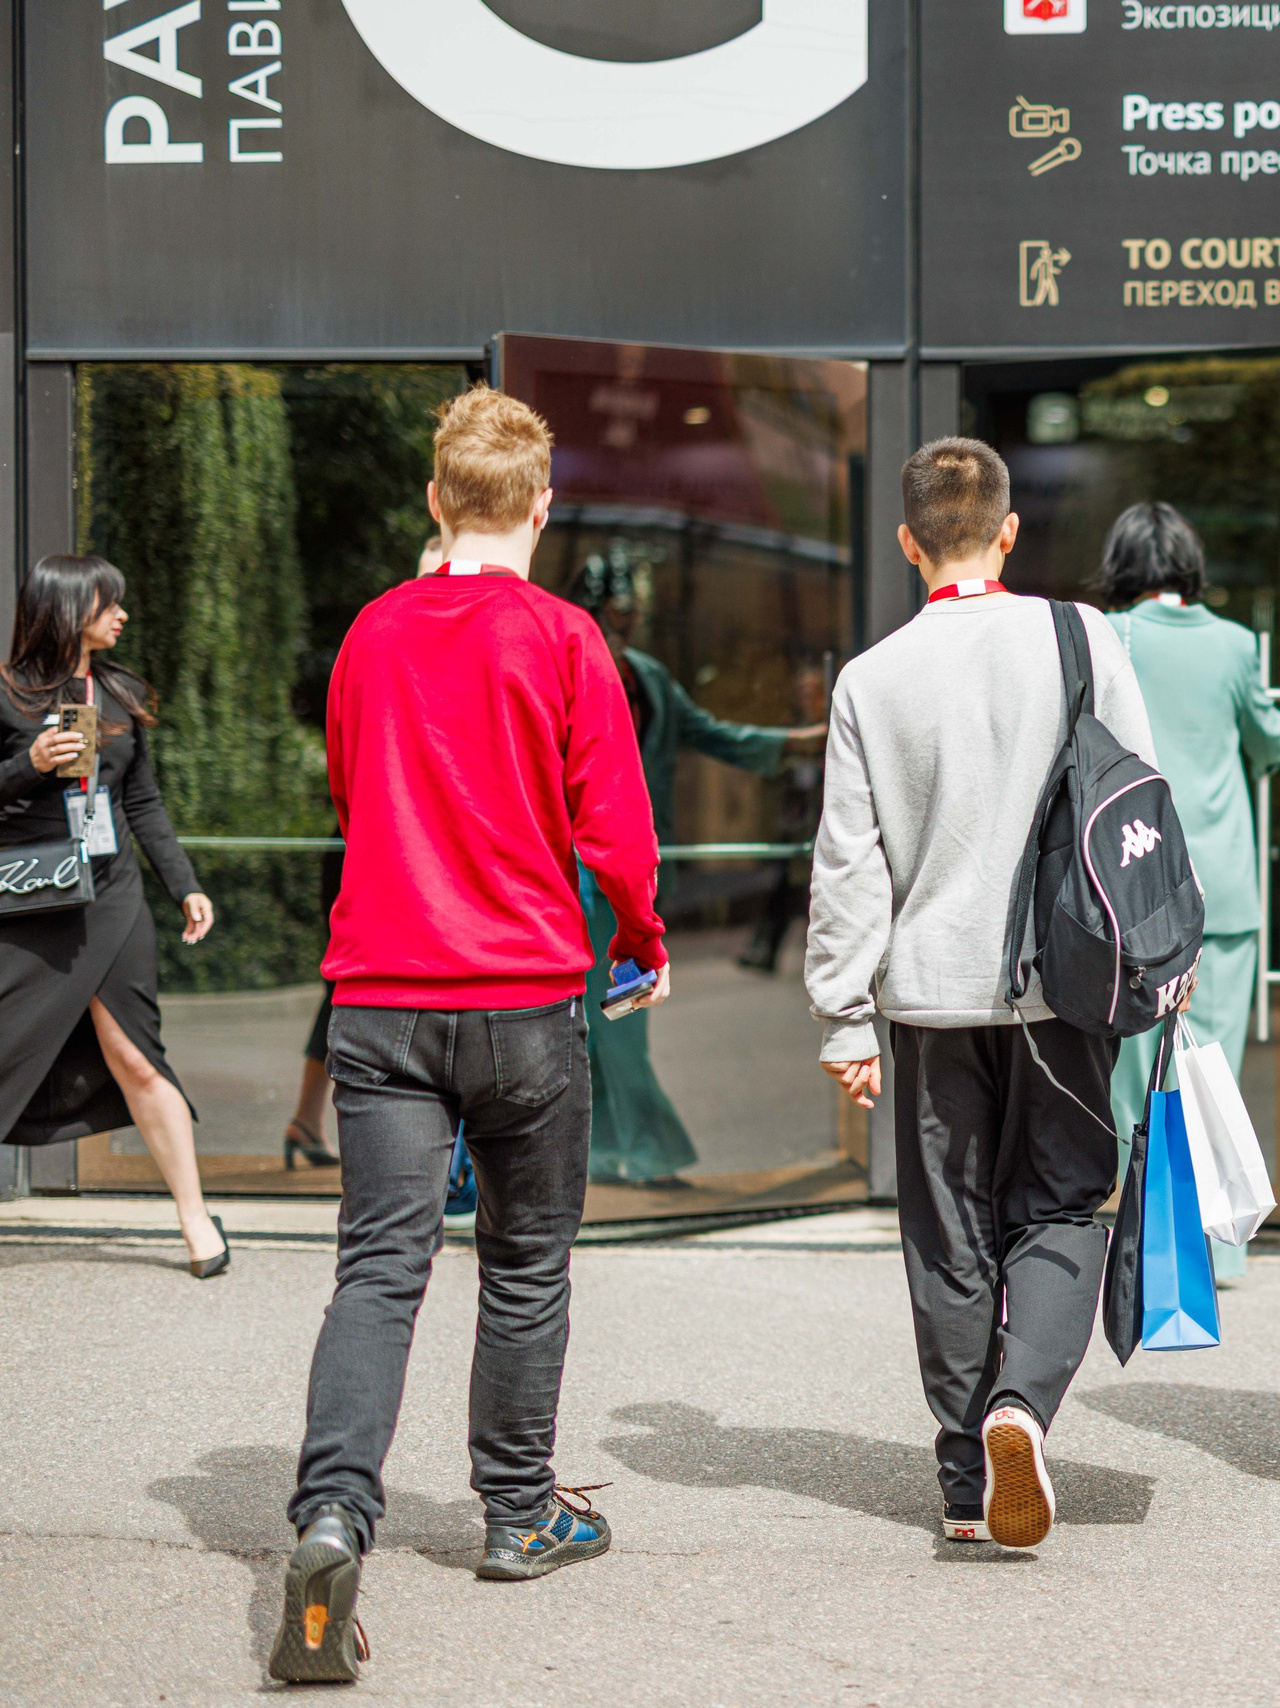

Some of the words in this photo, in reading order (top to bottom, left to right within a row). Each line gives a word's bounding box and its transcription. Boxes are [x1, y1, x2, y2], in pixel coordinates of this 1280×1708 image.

[103, 0, 203, 164] PA
[228, 0, 283, 162] ПАВ
[1123, 94, 1225, 131] Press
[1121, 145, 1212, 175] Точка
[1121, 238, 1172, 270] TO
[1123, 279, 1258, 309] ПЕРЕХОД
